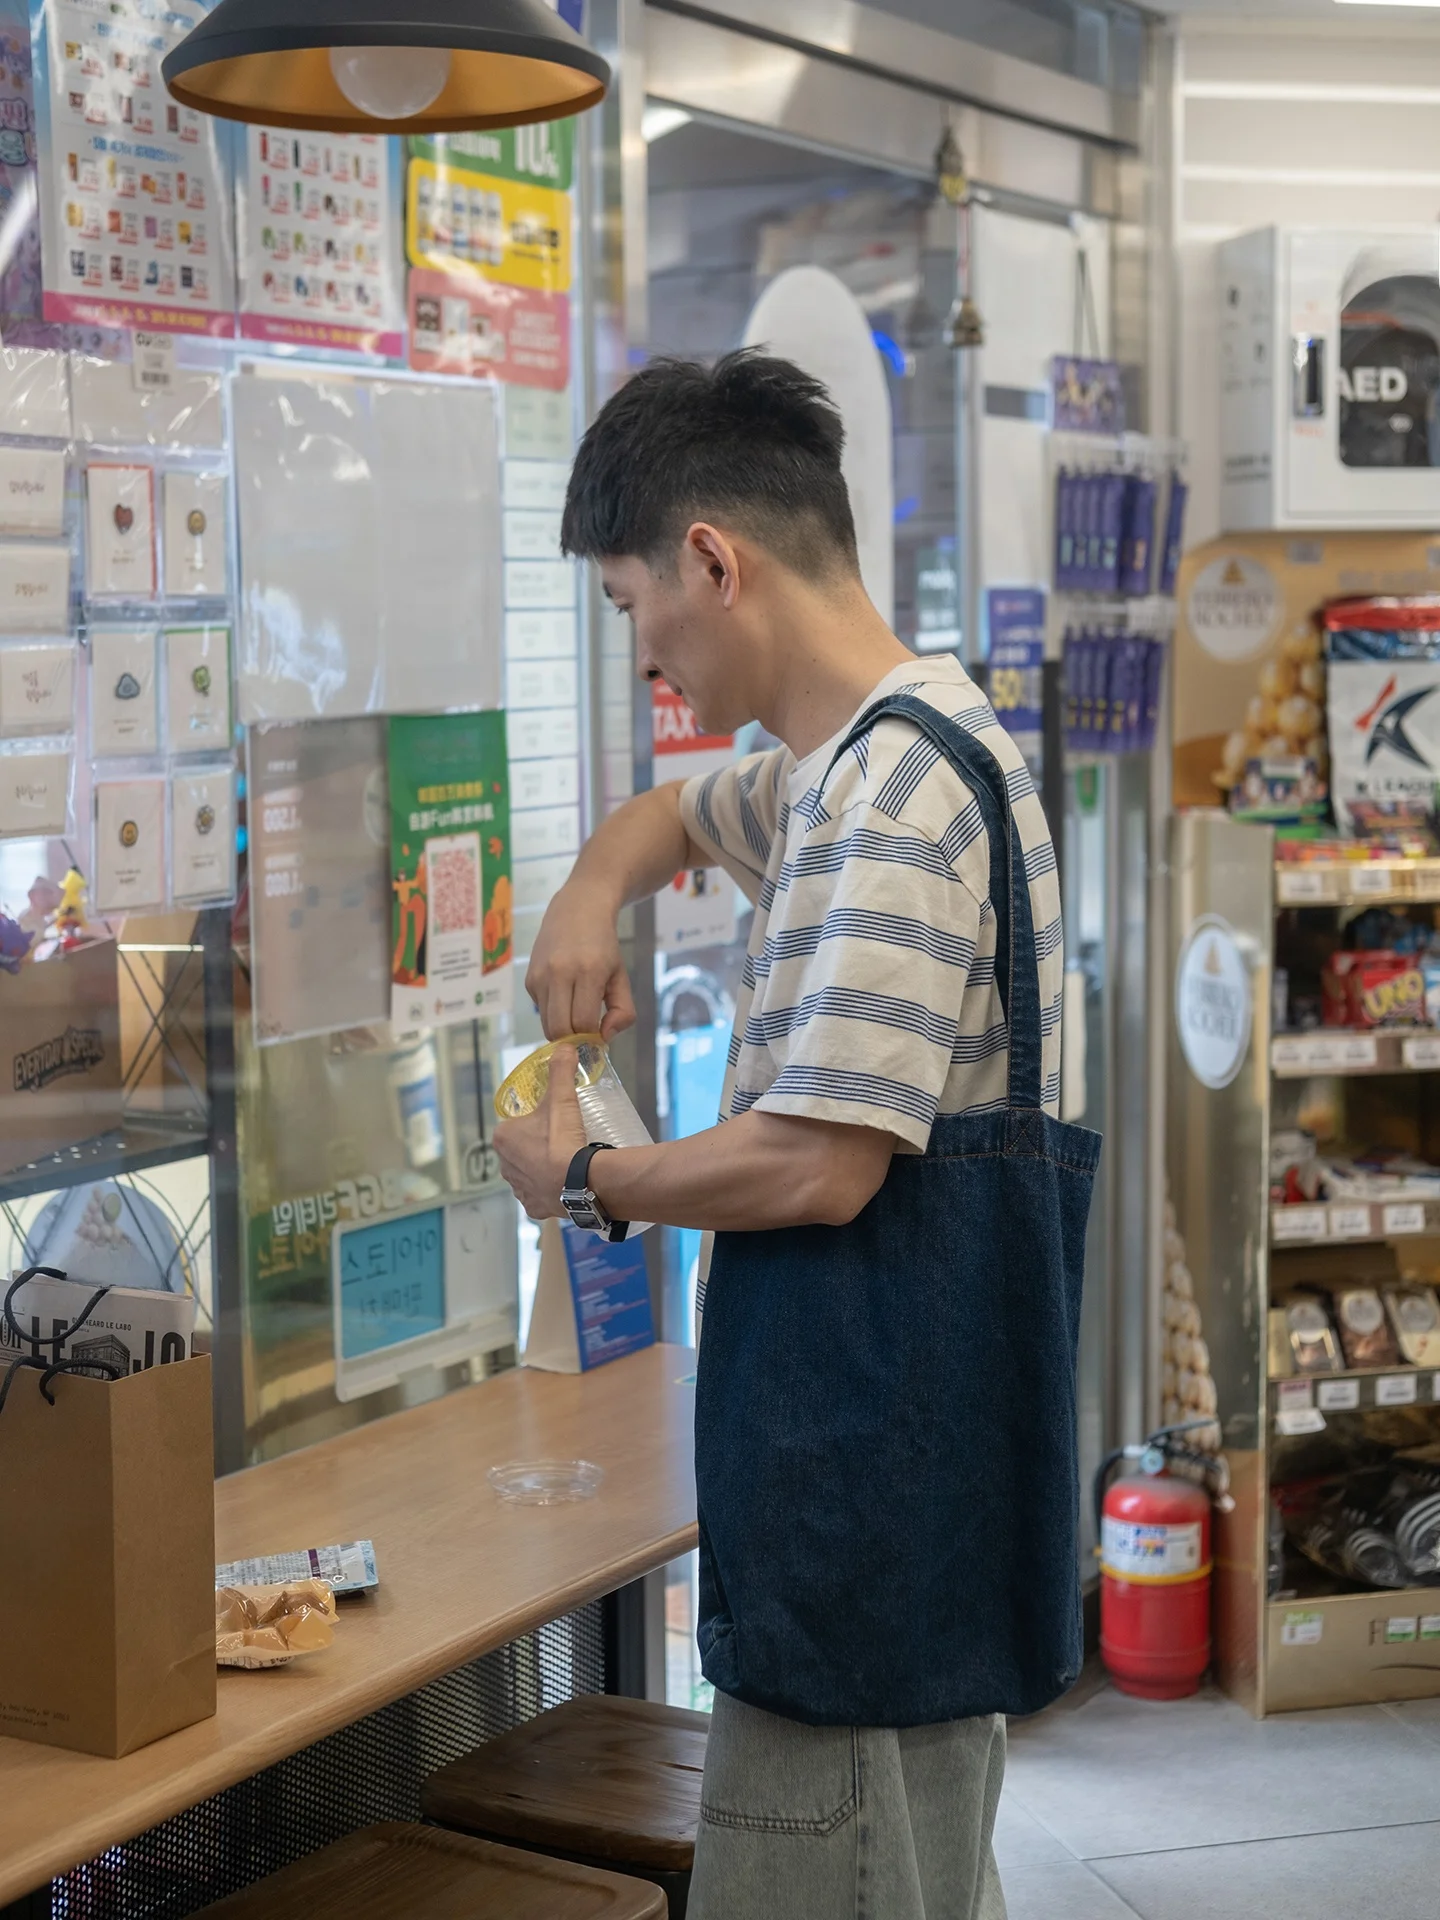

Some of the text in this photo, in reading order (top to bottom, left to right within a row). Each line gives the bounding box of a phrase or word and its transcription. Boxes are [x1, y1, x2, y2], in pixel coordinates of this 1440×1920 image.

[1335, 365, 1409, 403] AED
[1363, 968, 1424, 1019] UNO
[106, 1321, 114, 1329] LE
[115, 1322, 132, 1332] LABO
